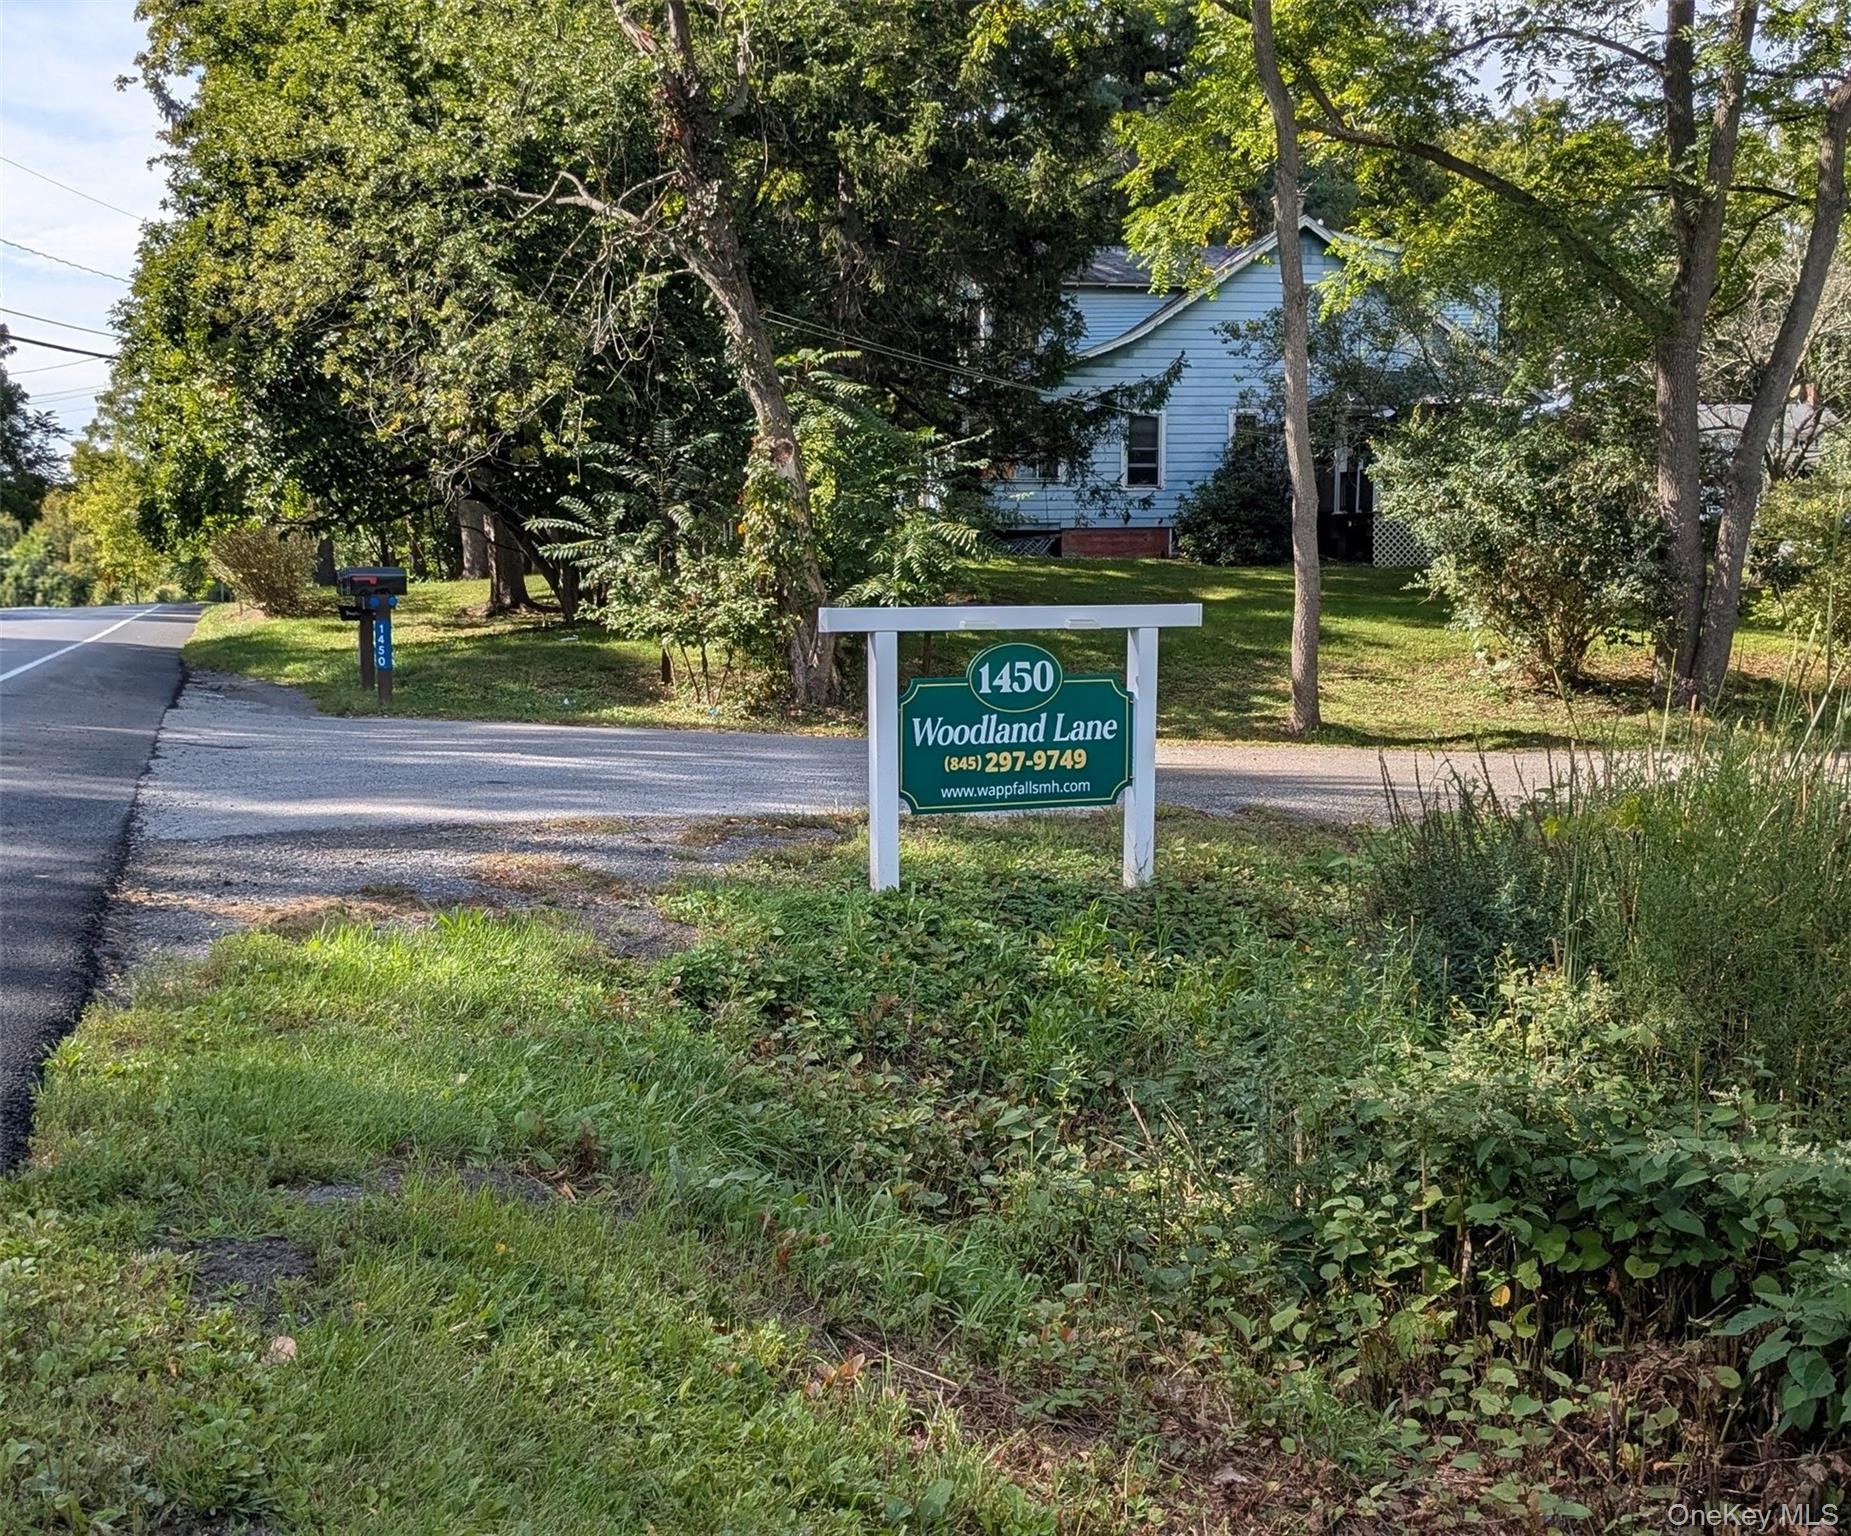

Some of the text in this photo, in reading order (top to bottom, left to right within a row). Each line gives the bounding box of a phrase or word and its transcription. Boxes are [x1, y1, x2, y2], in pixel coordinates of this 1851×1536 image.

[377, 624, 386, 667] 1450
[978, 660, 1054, 694] 1450
[912, 712, 1118, 747] Woodland Lane
[944, 748, 1087, 773] (845) 297-9749
[940, 779, 1091, 799] www.wappfallsmh.com
